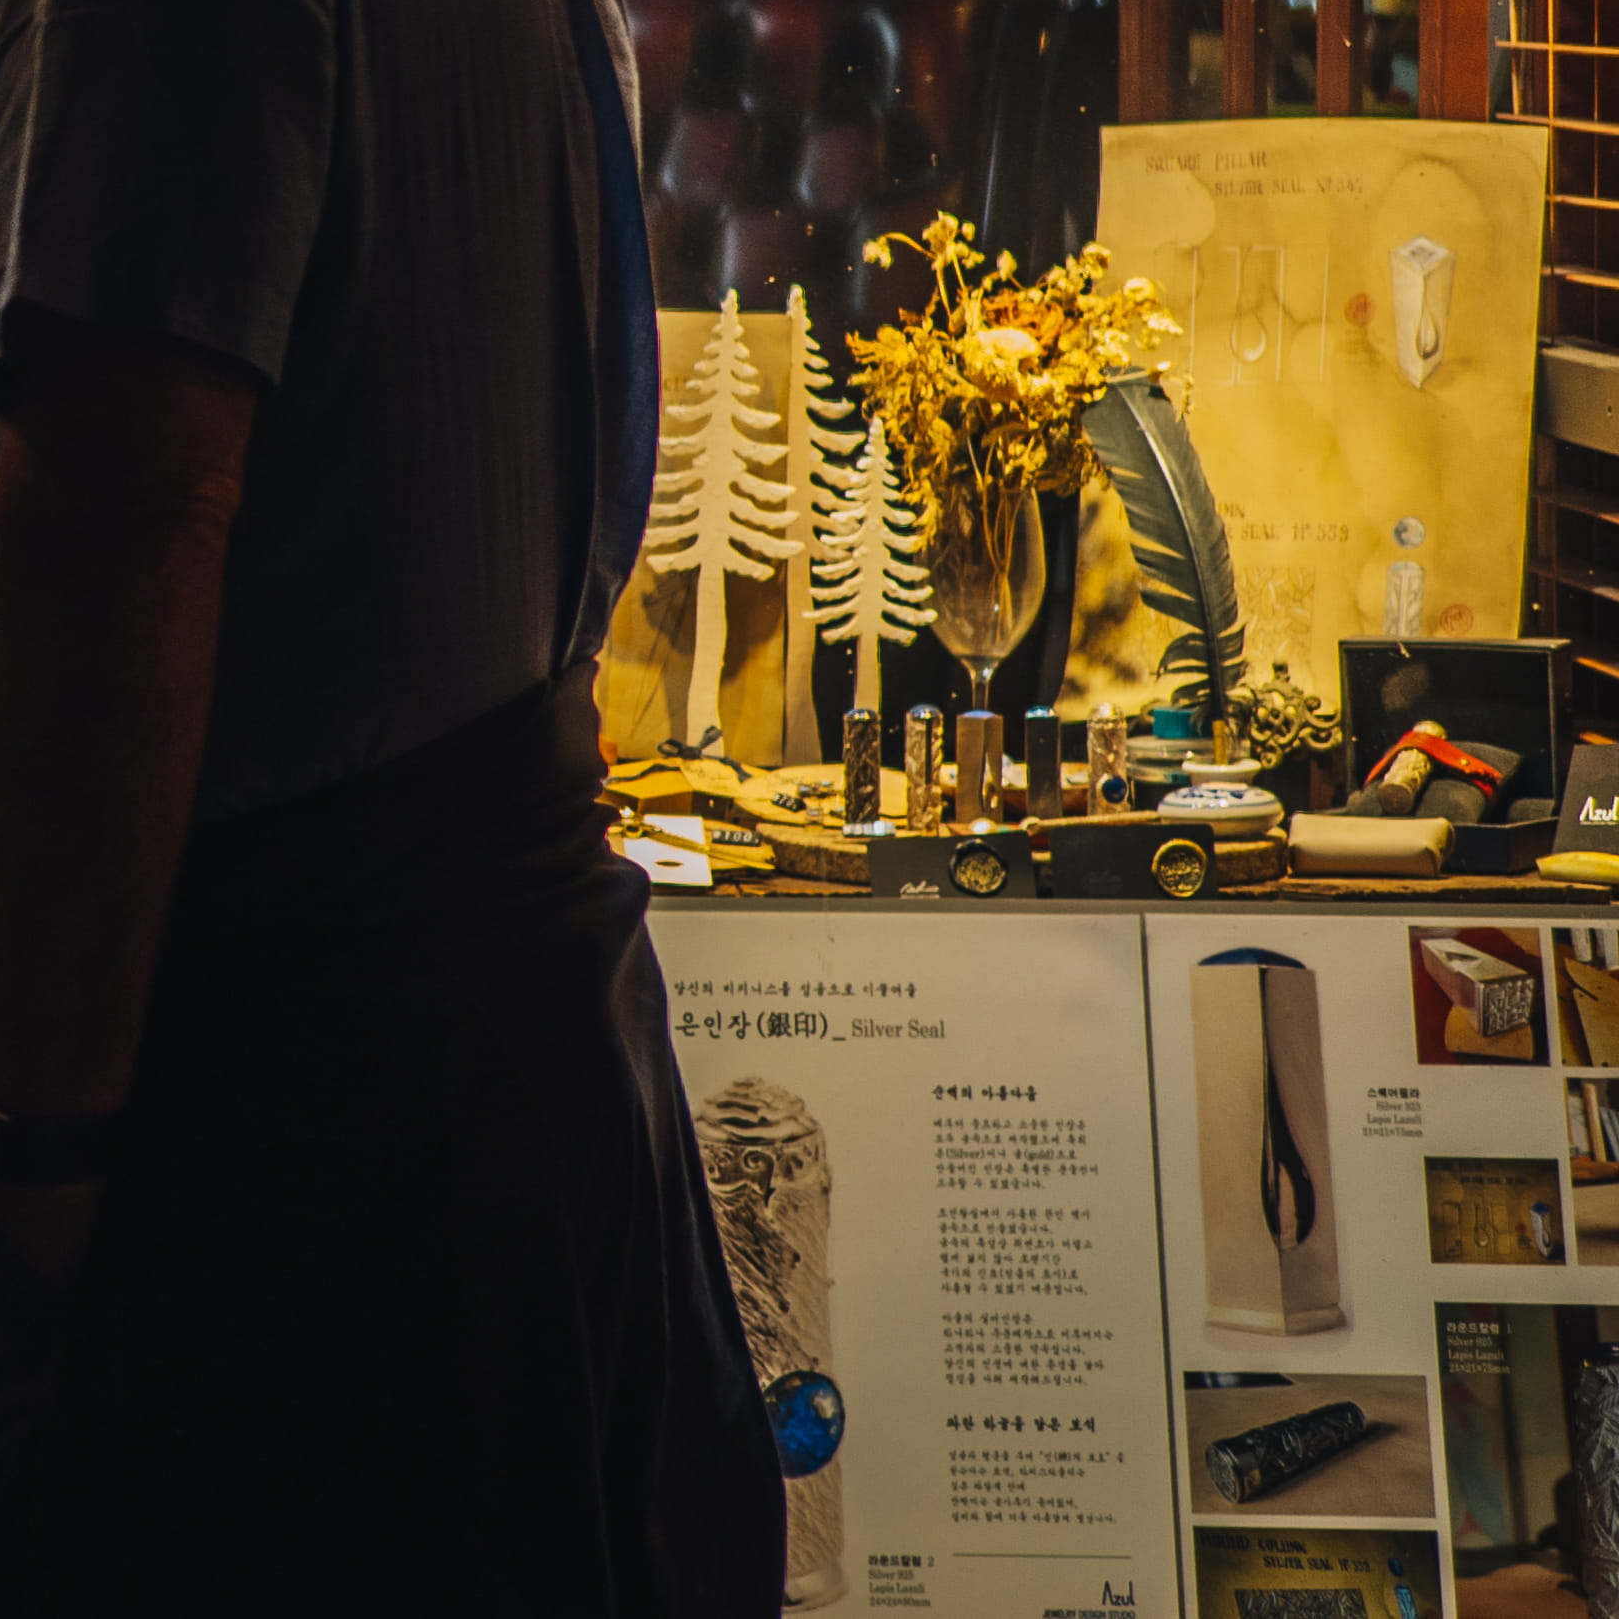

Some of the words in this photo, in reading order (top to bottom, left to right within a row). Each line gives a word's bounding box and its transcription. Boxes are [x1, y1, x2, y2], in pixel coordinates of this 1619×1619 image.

[851, 1019, 903, 1038] Silver
[908, 1019, 946, 1039] Seal
[927, 1554, 935, 1567] 2
[1102, 1580, 1135, 1606] Azul
